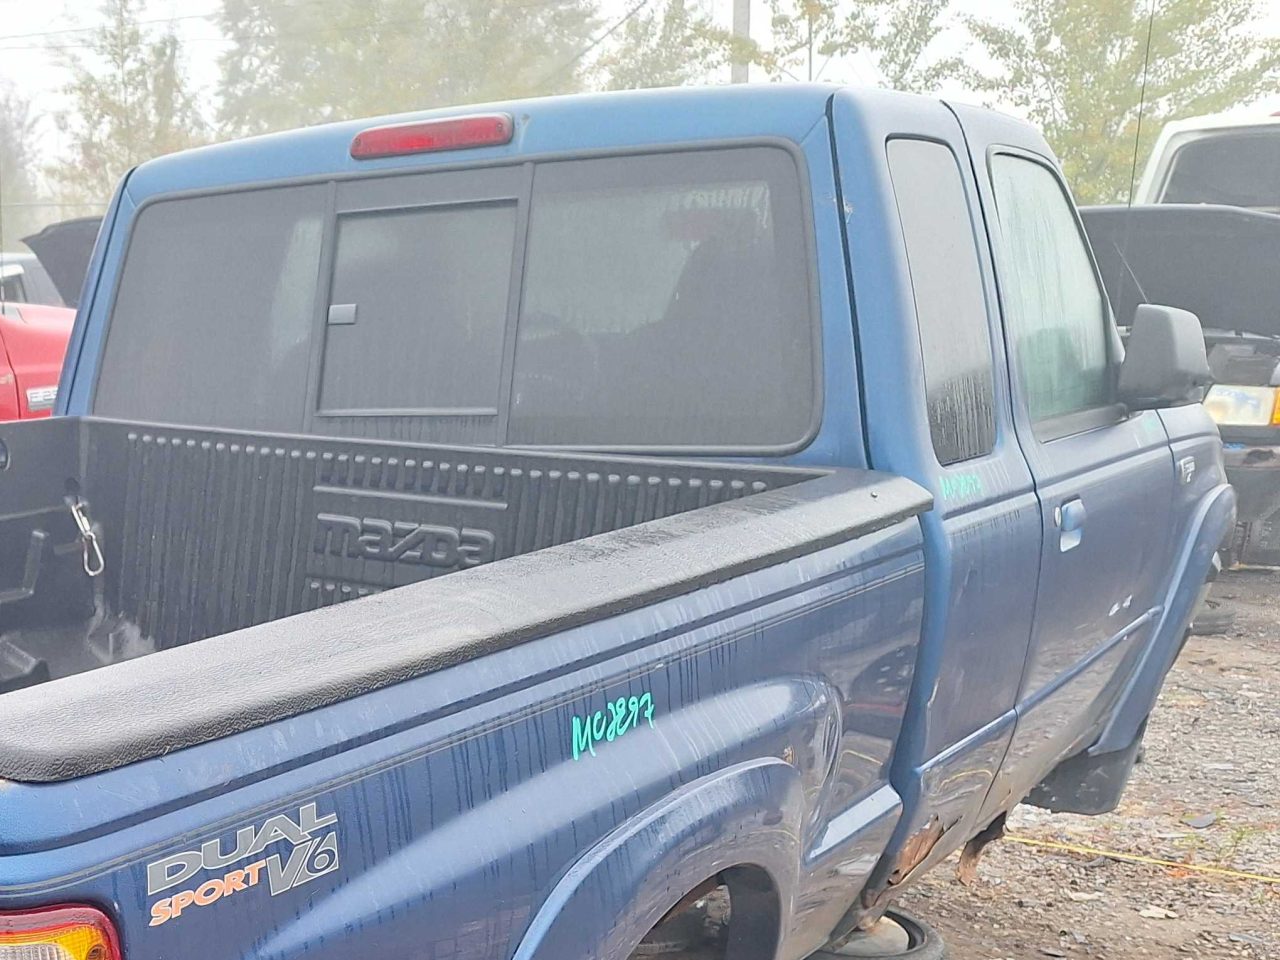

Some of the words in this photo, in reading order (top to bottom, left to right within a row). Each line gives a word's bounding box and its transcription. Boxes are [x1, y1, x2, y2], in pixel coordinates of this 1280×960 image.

[147, 802, 338, 896] DUAL
[148, 860, 266, 927] SPORT
[266, 832, 340, 897] V6
